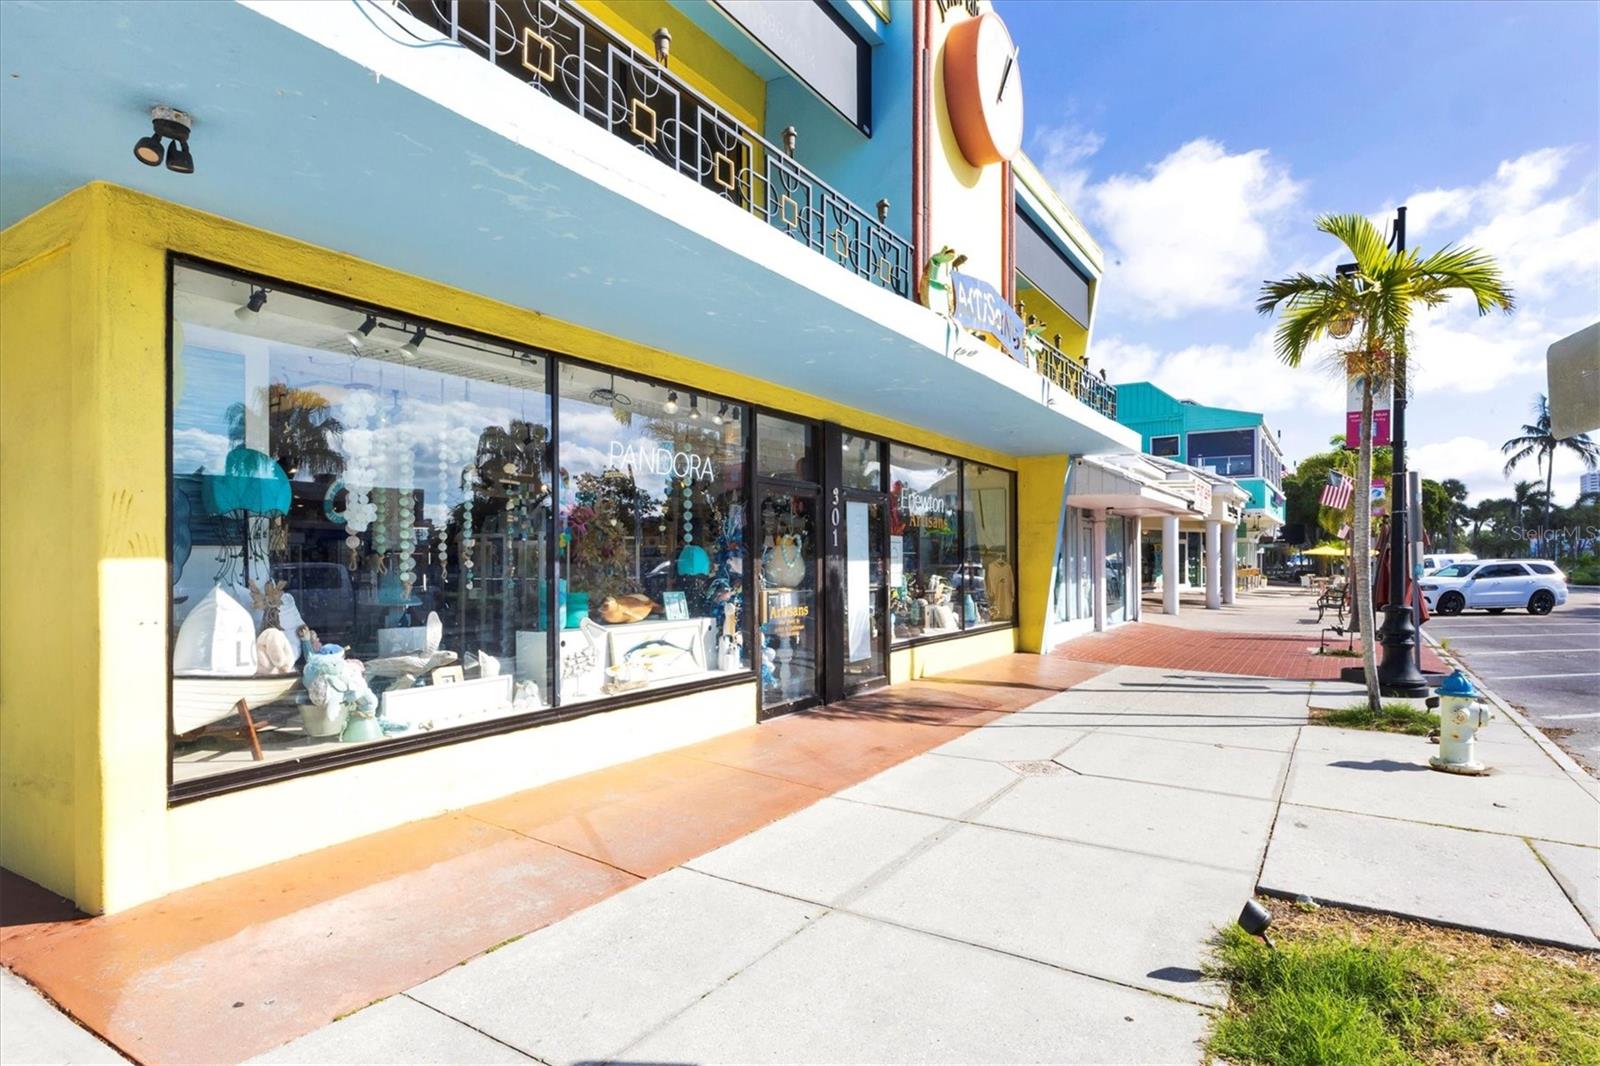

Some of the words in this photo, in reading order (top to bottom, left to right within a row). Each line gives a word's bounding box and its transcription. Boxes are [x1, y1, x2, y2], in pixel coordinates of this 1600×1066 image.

[608, 440, 715, 482] PANDORA
[831, 487, 840, 547] 301
[770, 605, 809, 619] Artisans
